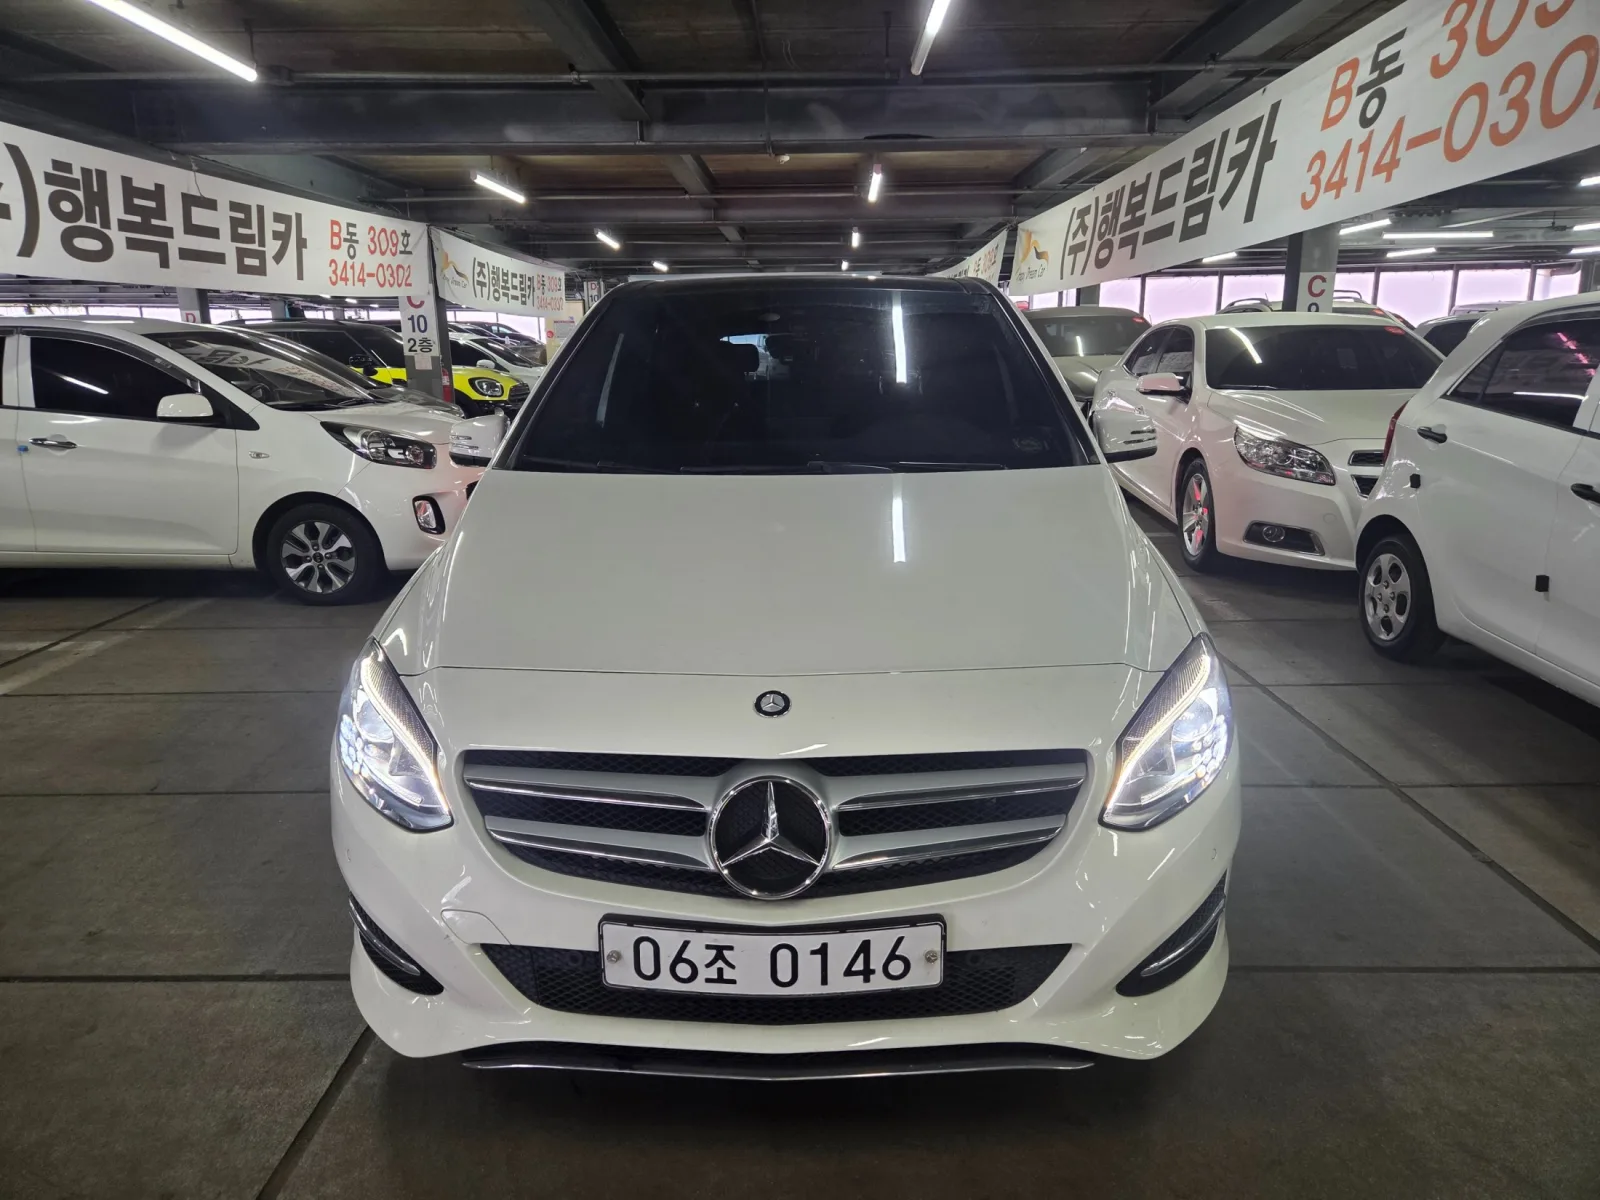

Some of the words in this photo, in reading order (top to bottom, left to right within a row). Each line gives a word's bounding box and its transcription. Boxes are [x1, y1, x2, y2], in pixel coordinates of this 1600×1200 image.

[1320, 27, 1408, 131] B동
[1300, 34, 1600, 211] 3414-030
[0, 142, 308, 281] )행복드림카
[1060, 99, 1282, 281] (주)행복드림카
[330, 219, 360, 260] B동
[367, 225, 413, 258] 309호
[328, 258, 413, 288] 3414-0302
[472, 257, 535, 307] (주)행복드림카
[590, 282, 598, 291] D
[1307, 274, 1327, 298] C
[407, 314, 428, 333] 10
[407, 337, 434, 353] 2층
[632, 935, 737, 985] 06조
[769, 935, 912, 988] 0146
